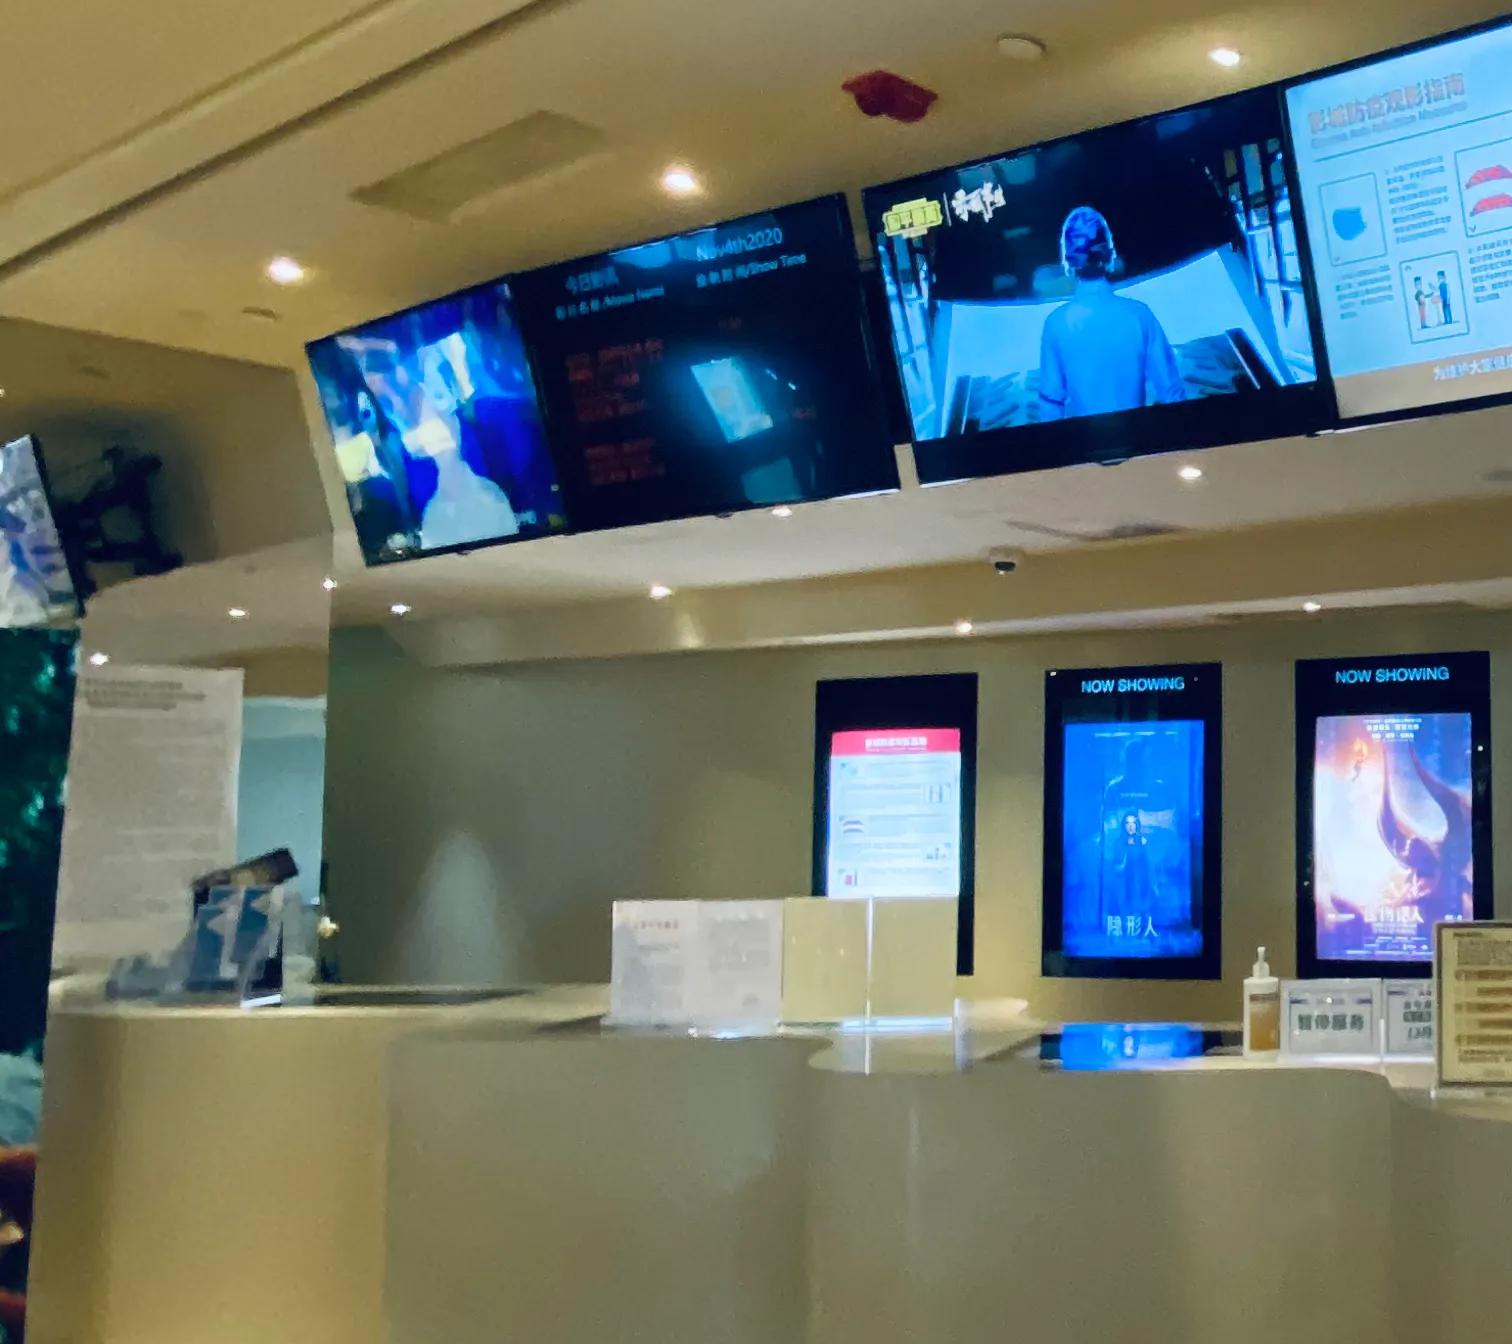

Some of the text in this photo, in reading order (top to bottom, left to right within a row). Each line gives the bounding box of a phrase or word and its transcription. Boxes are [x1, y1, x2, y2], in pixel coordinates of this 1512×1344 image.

[1335, 666, 1450, 684] NOW SHOWING
[1081, 676, 1186, 694] NOW SHOWING
[1106, 914, 1159, 938] 隐形人
